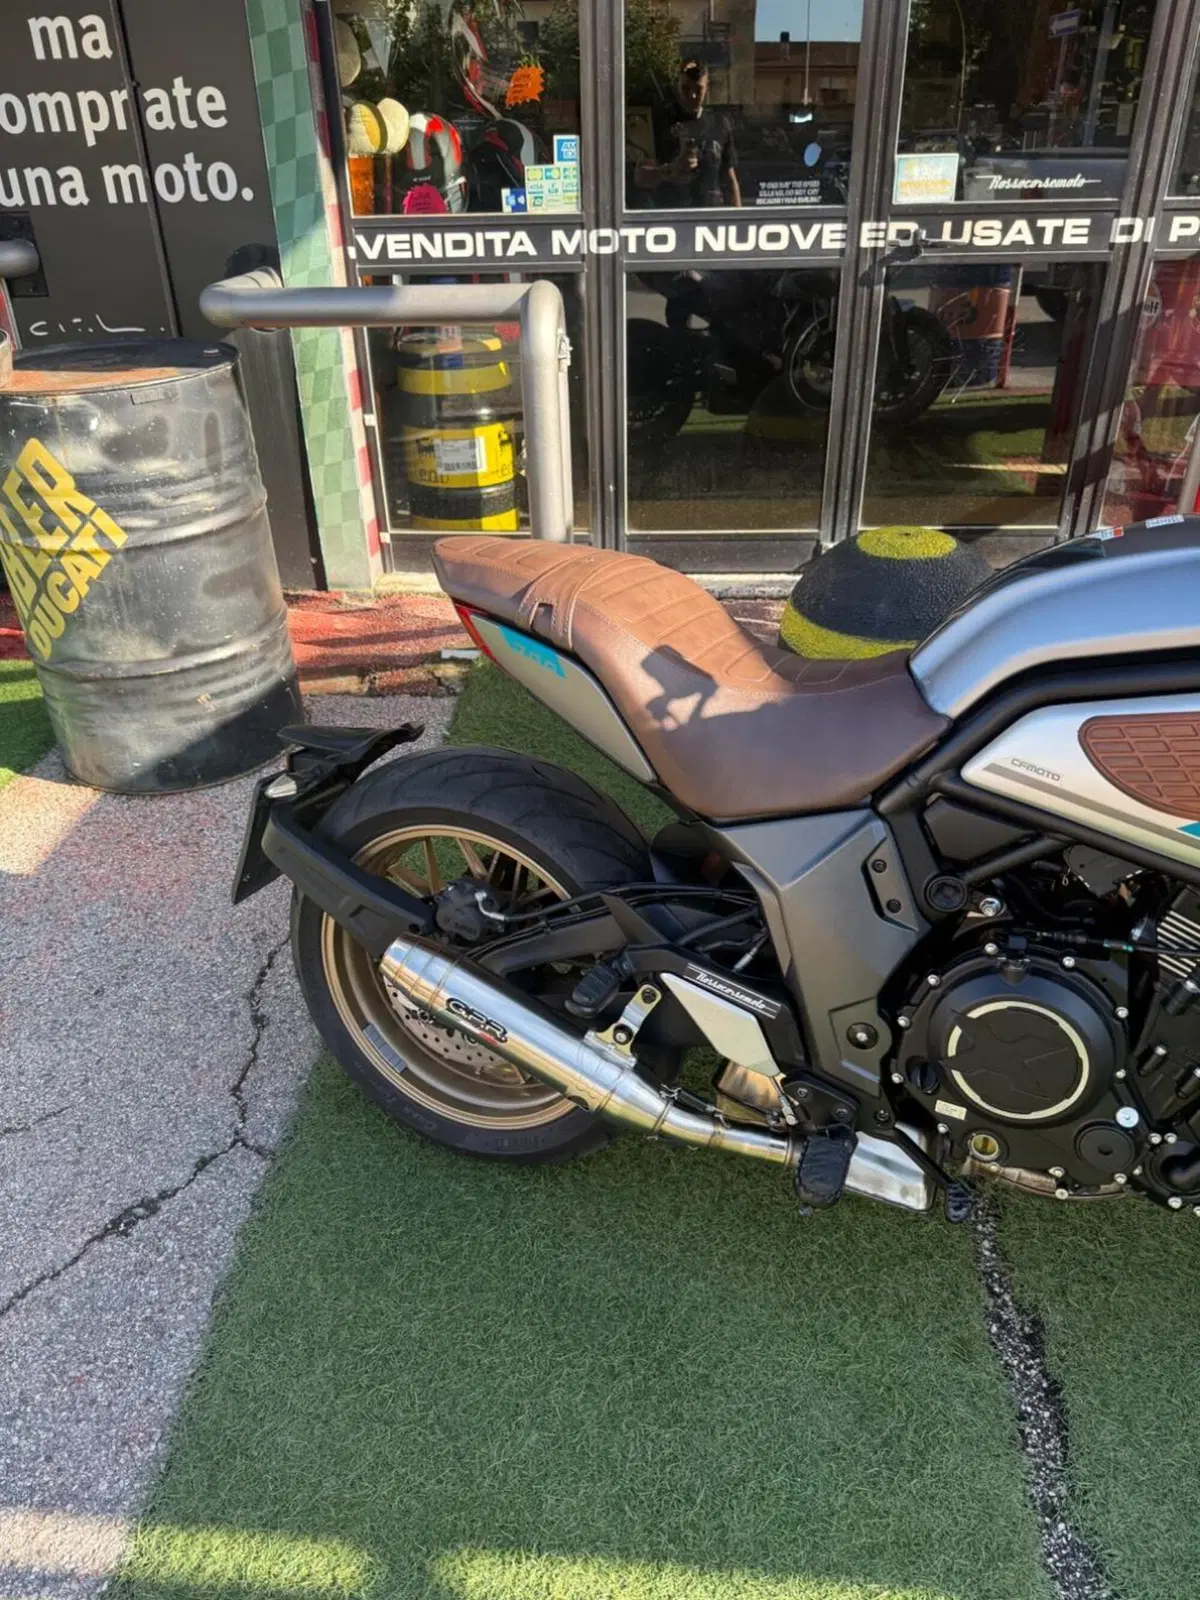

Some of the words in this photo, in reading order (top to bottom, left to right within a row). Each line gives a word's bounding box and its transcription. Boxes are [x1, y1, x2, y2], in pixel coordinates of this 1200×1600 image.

[27, 13, 113, 60] ma
[0, 165, 90, 207] una
[101, 152, 254, 205] moto.
[551, 227, 677, 256] MOTO
[694, 223, 848, 252] NUOVE
[859, 221, 919, 248] ED
[940, 218, 1091, 246] USATE
[1109, 216, 1156, 244] DI
[1168, 215, 1200, 242] P
[29, 507, 129, 661] DUCATI
[1010, 758, 1061, 782] CFMOTO
[446, 997, 508, 1043] GPR
